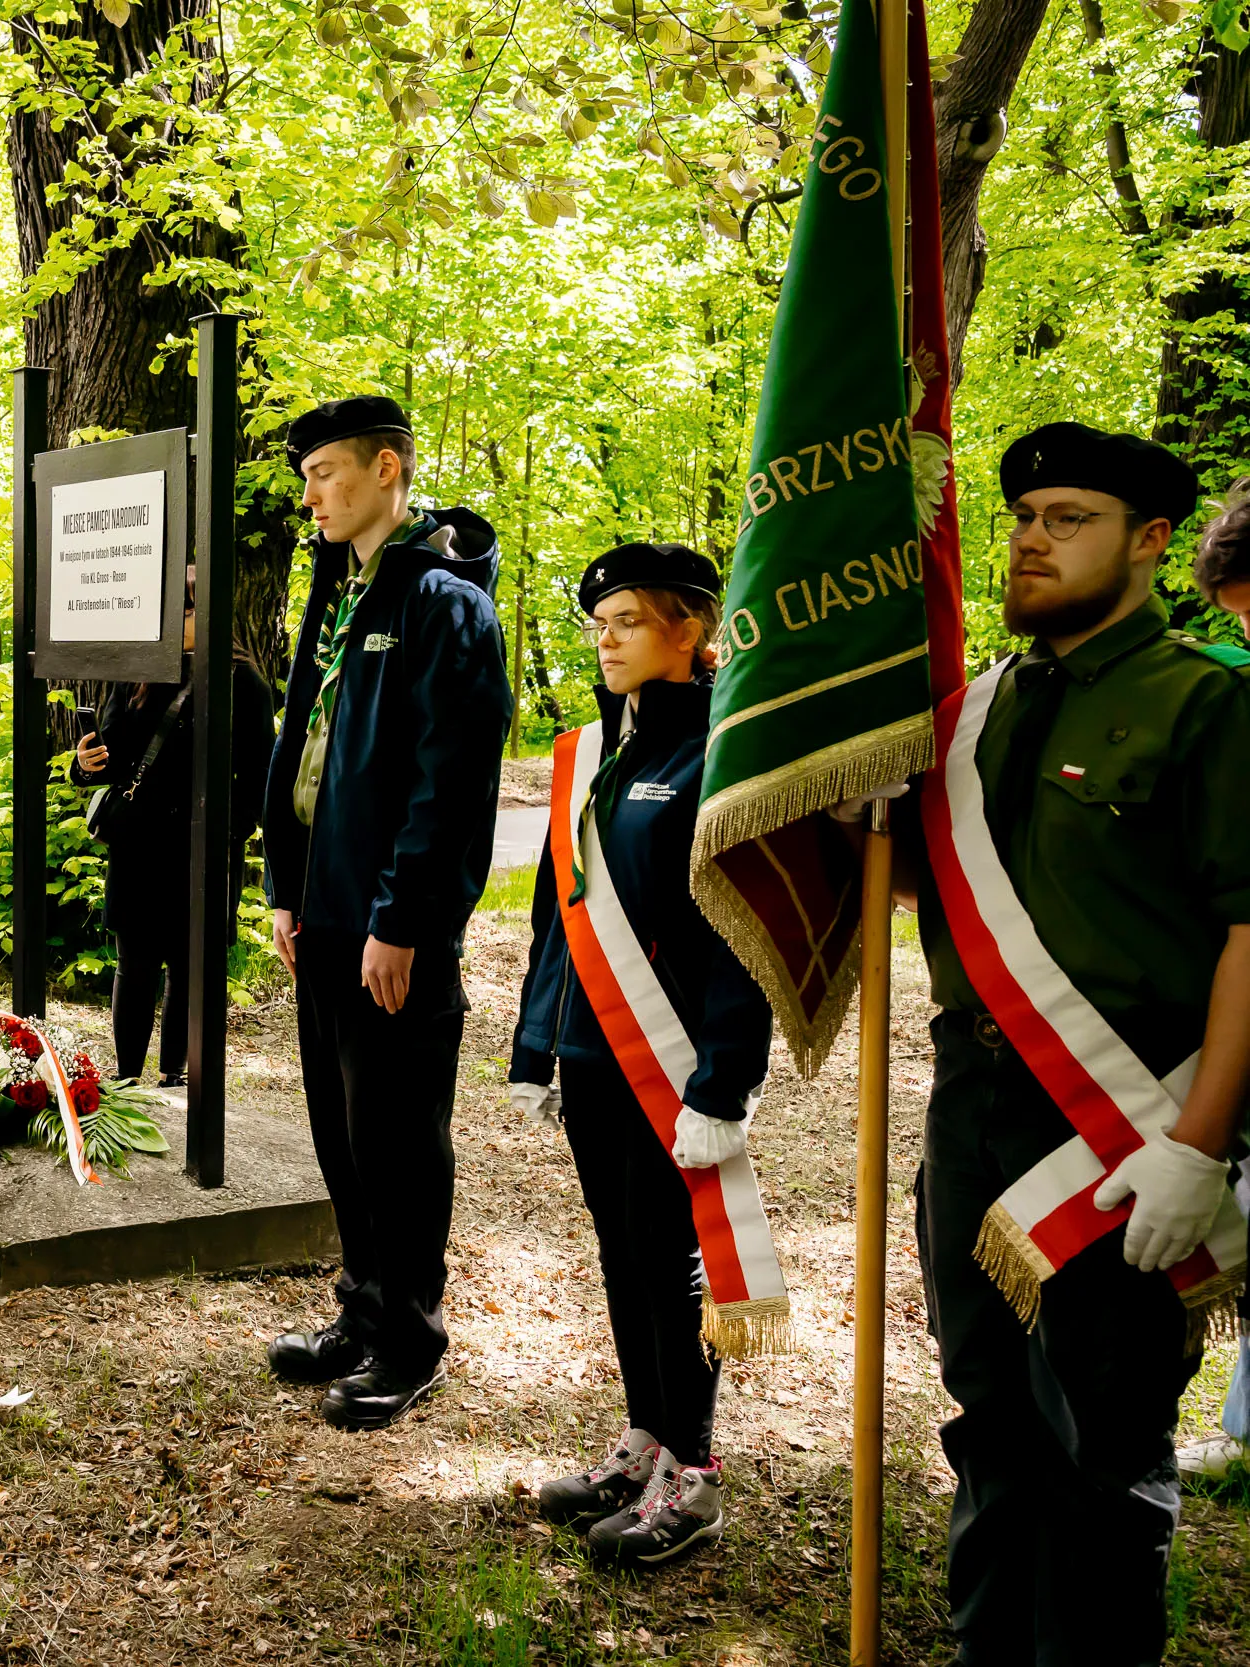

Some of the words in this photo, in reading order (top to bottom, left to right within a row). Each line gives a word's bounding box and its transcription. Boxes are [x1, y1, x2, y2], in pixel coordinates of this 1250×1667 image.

[62, 512, 86, 535] MIEJSCE
[86, 509, 111, 534] PAMIĘCI
[111, 504, 150, 530] NARODOWEJ
[95, 547, 110, 560] latach
[90, 572, 96, 584] KL
[96, 571, 110, 584] Gross
[112, 570, 127, 582] Rosen
[67, 599, 75, 611] AL
[75, 598, 111, 611] Fürstenstein
